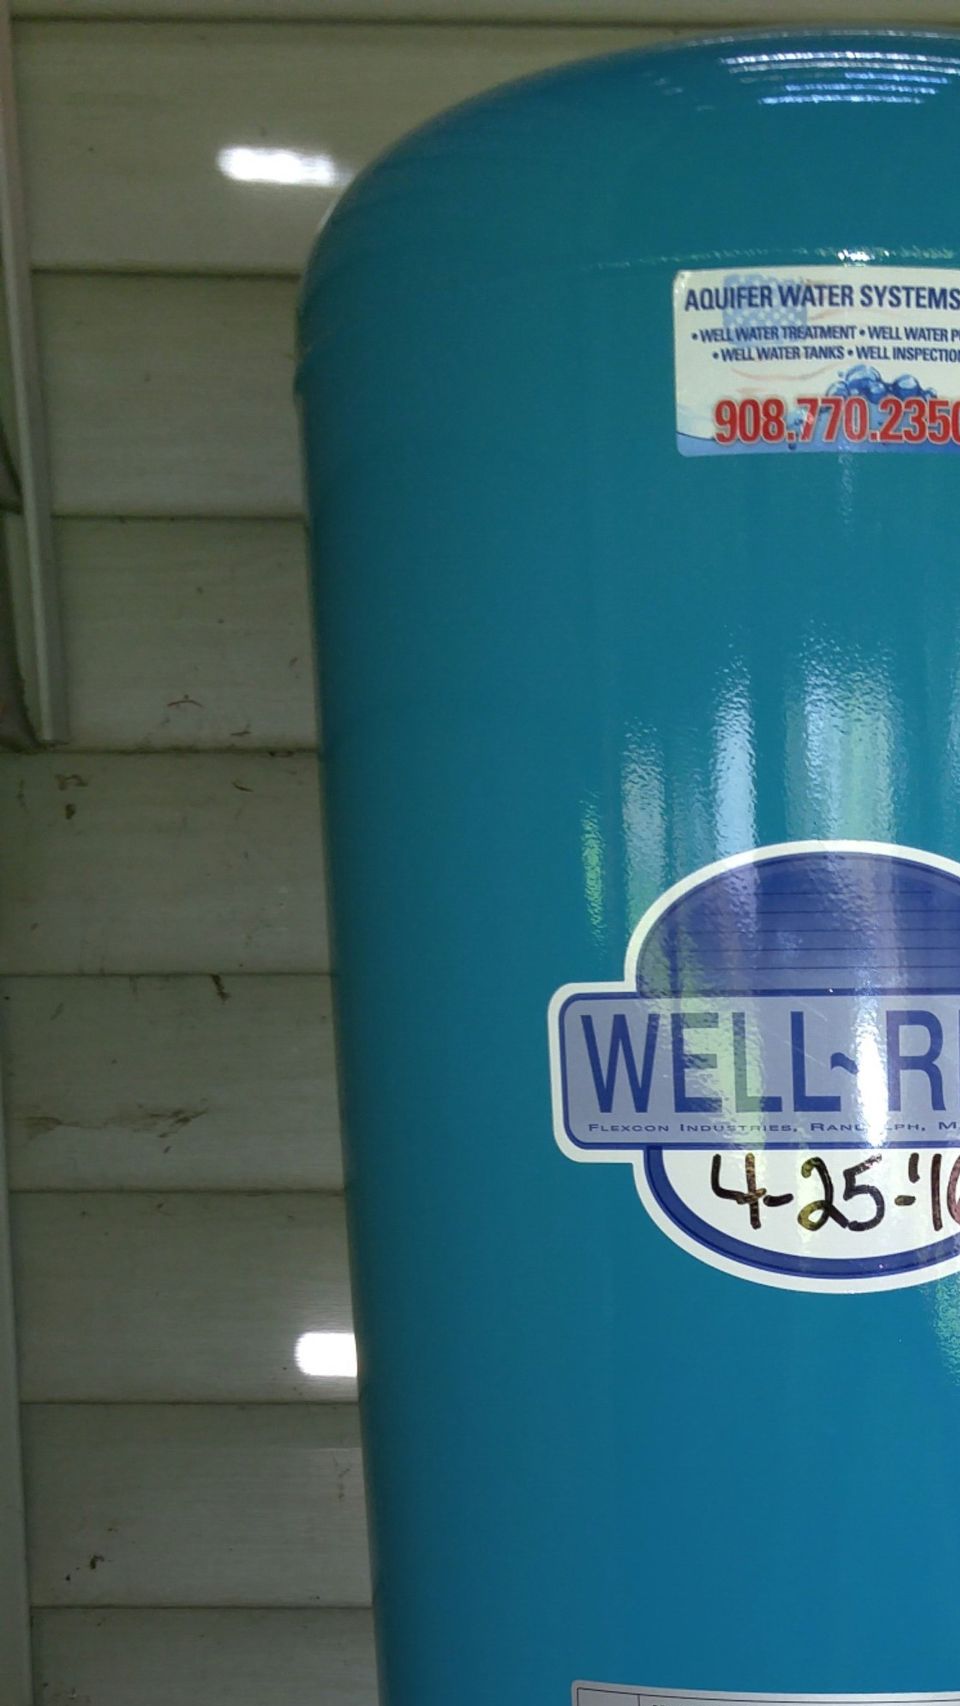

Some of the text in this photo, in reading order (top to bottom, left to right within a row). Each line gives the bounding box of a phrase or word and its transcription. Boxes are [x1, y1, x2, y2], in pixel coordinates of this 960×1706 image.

[684, 286, 773, 311] AQUIFER
[779, 285, 854, 308] WATER
[861, 285, 960, 311] SYSTEMS
[700, 327, 734, 342] WELL
[735, 327, 779, 342] WATER
[782, 326, 857, 340] TREATMENT
[868, 327, 900, 341] WELL
[904, 327, 950, 342] WATER
[721, 347, 754, 361] WELL
[758, 347, 802, 361] WATER
[804, 345, 845, 359] TANKS
[856, 347, 890, 361] WELL
